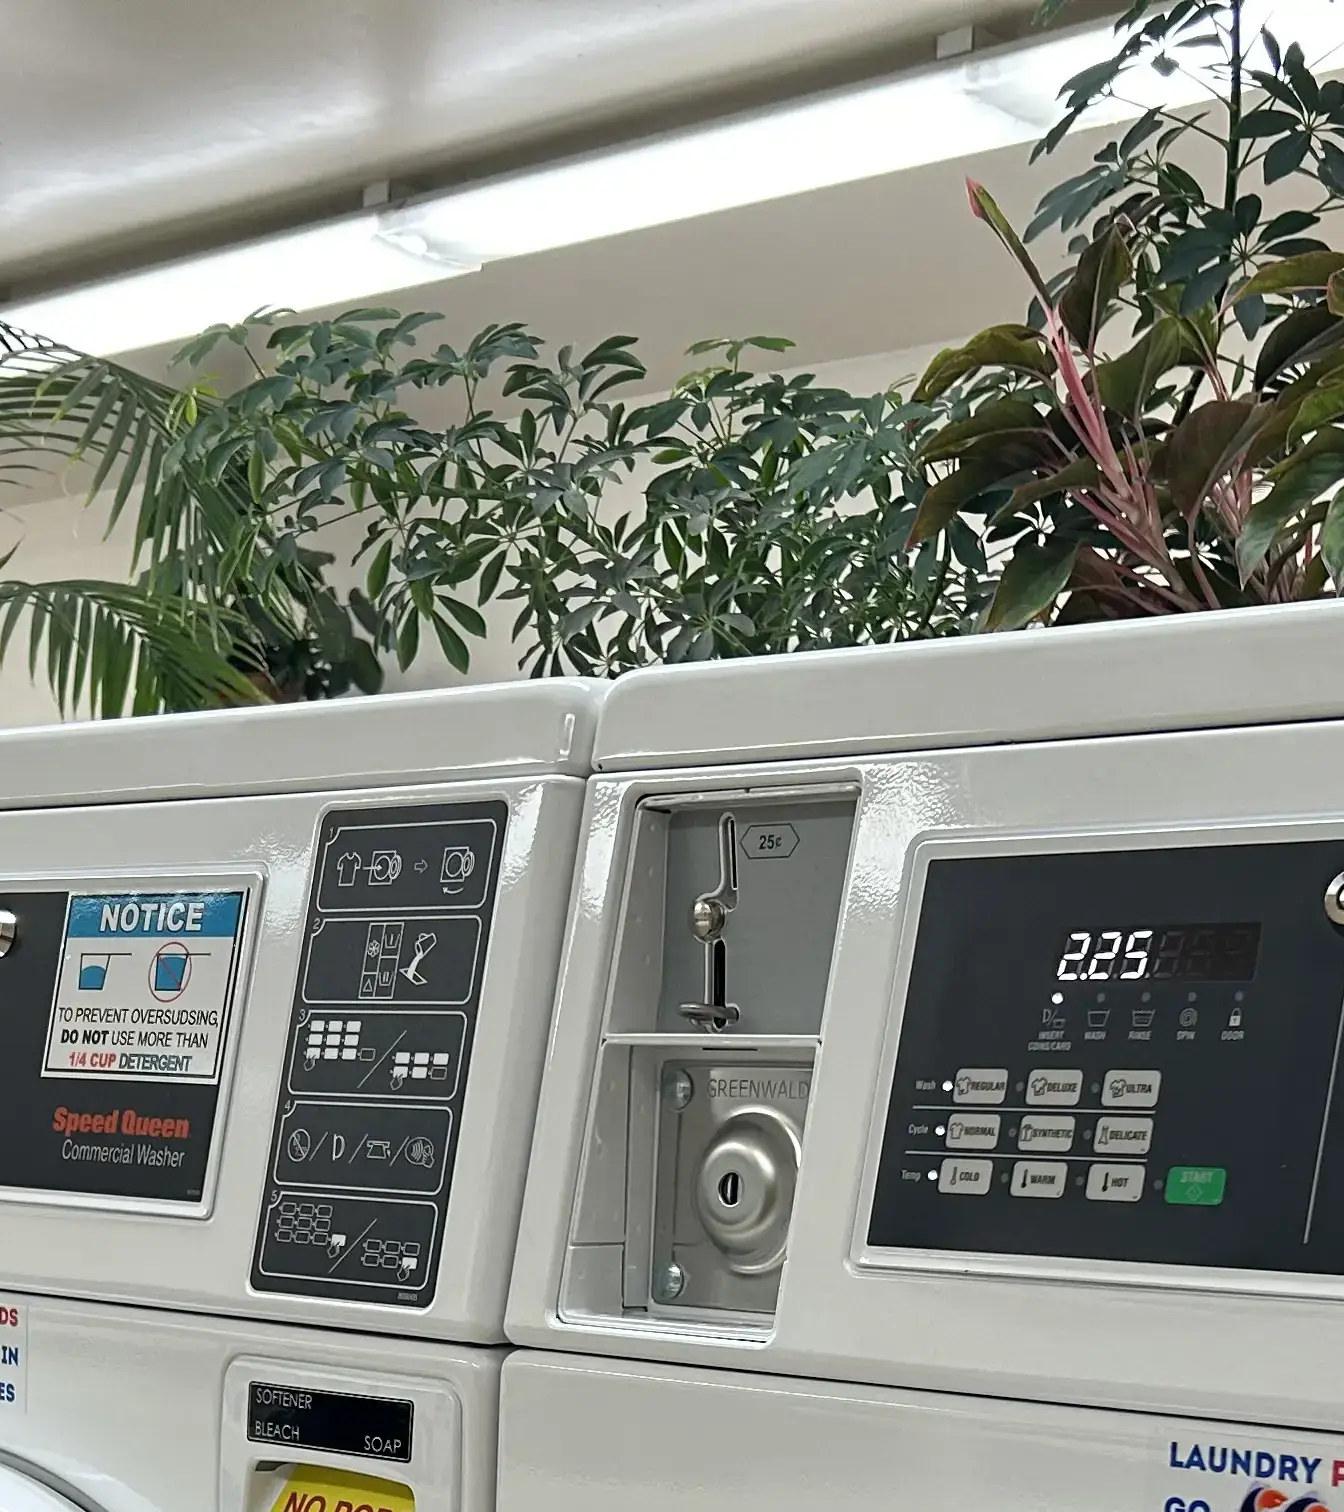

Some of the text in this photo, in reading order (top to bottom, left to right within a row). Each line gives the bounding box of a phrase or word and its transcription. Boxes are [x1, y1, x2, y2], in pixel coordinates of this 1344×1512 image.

[758, 834, 782, 850] 25¢
[99, 901, 205, 933] NOTICE
[1056, 930, 1154, 981] 2.25
[58, 1007, 219, 1028] TO PREVENT OVERSUDSING,
[60, 1029, 208, 1048] DO NOT USE MORE THAN
[69, 1052, 192, 1072] 1/4 CUP DETERGENT
[707, 1079, 810, 1099] GREENWALD
[970, 1081, 1006, 1092] REGULAR
[1047, 1082, 1079, 1093] DELUXE
[1126, 1084, 1153, 1094] ULTRA
[53, 1106, 190, 1139] Speed Queen
[908, 1123, 929, 1135] Cycle
[963, 1126, 996, 1137] NORMAL
[1032, 1128, 1073, 1139] SYNTHETIC
[1109, 1130, 1148, 1141] DELICATE
[61, 1139, 185, 1168] Commercial Washer
[901, 1169, 921, 1182] Temp
[959, 1171, 980, 1182] COLD
[1030, 1174, 1056, 1185] WARM
[1111, 1177, 1129, 1188] HOT
[1, 1345, 19, 1366] IN
[256, 1387, 313, 1410] SOFTENER
[254, 1420, 300, 1441] BLEACH
[364, 1435, 402, 1454] SOAP
[1169, 1441, 1323, 1484] LAUNDRY
